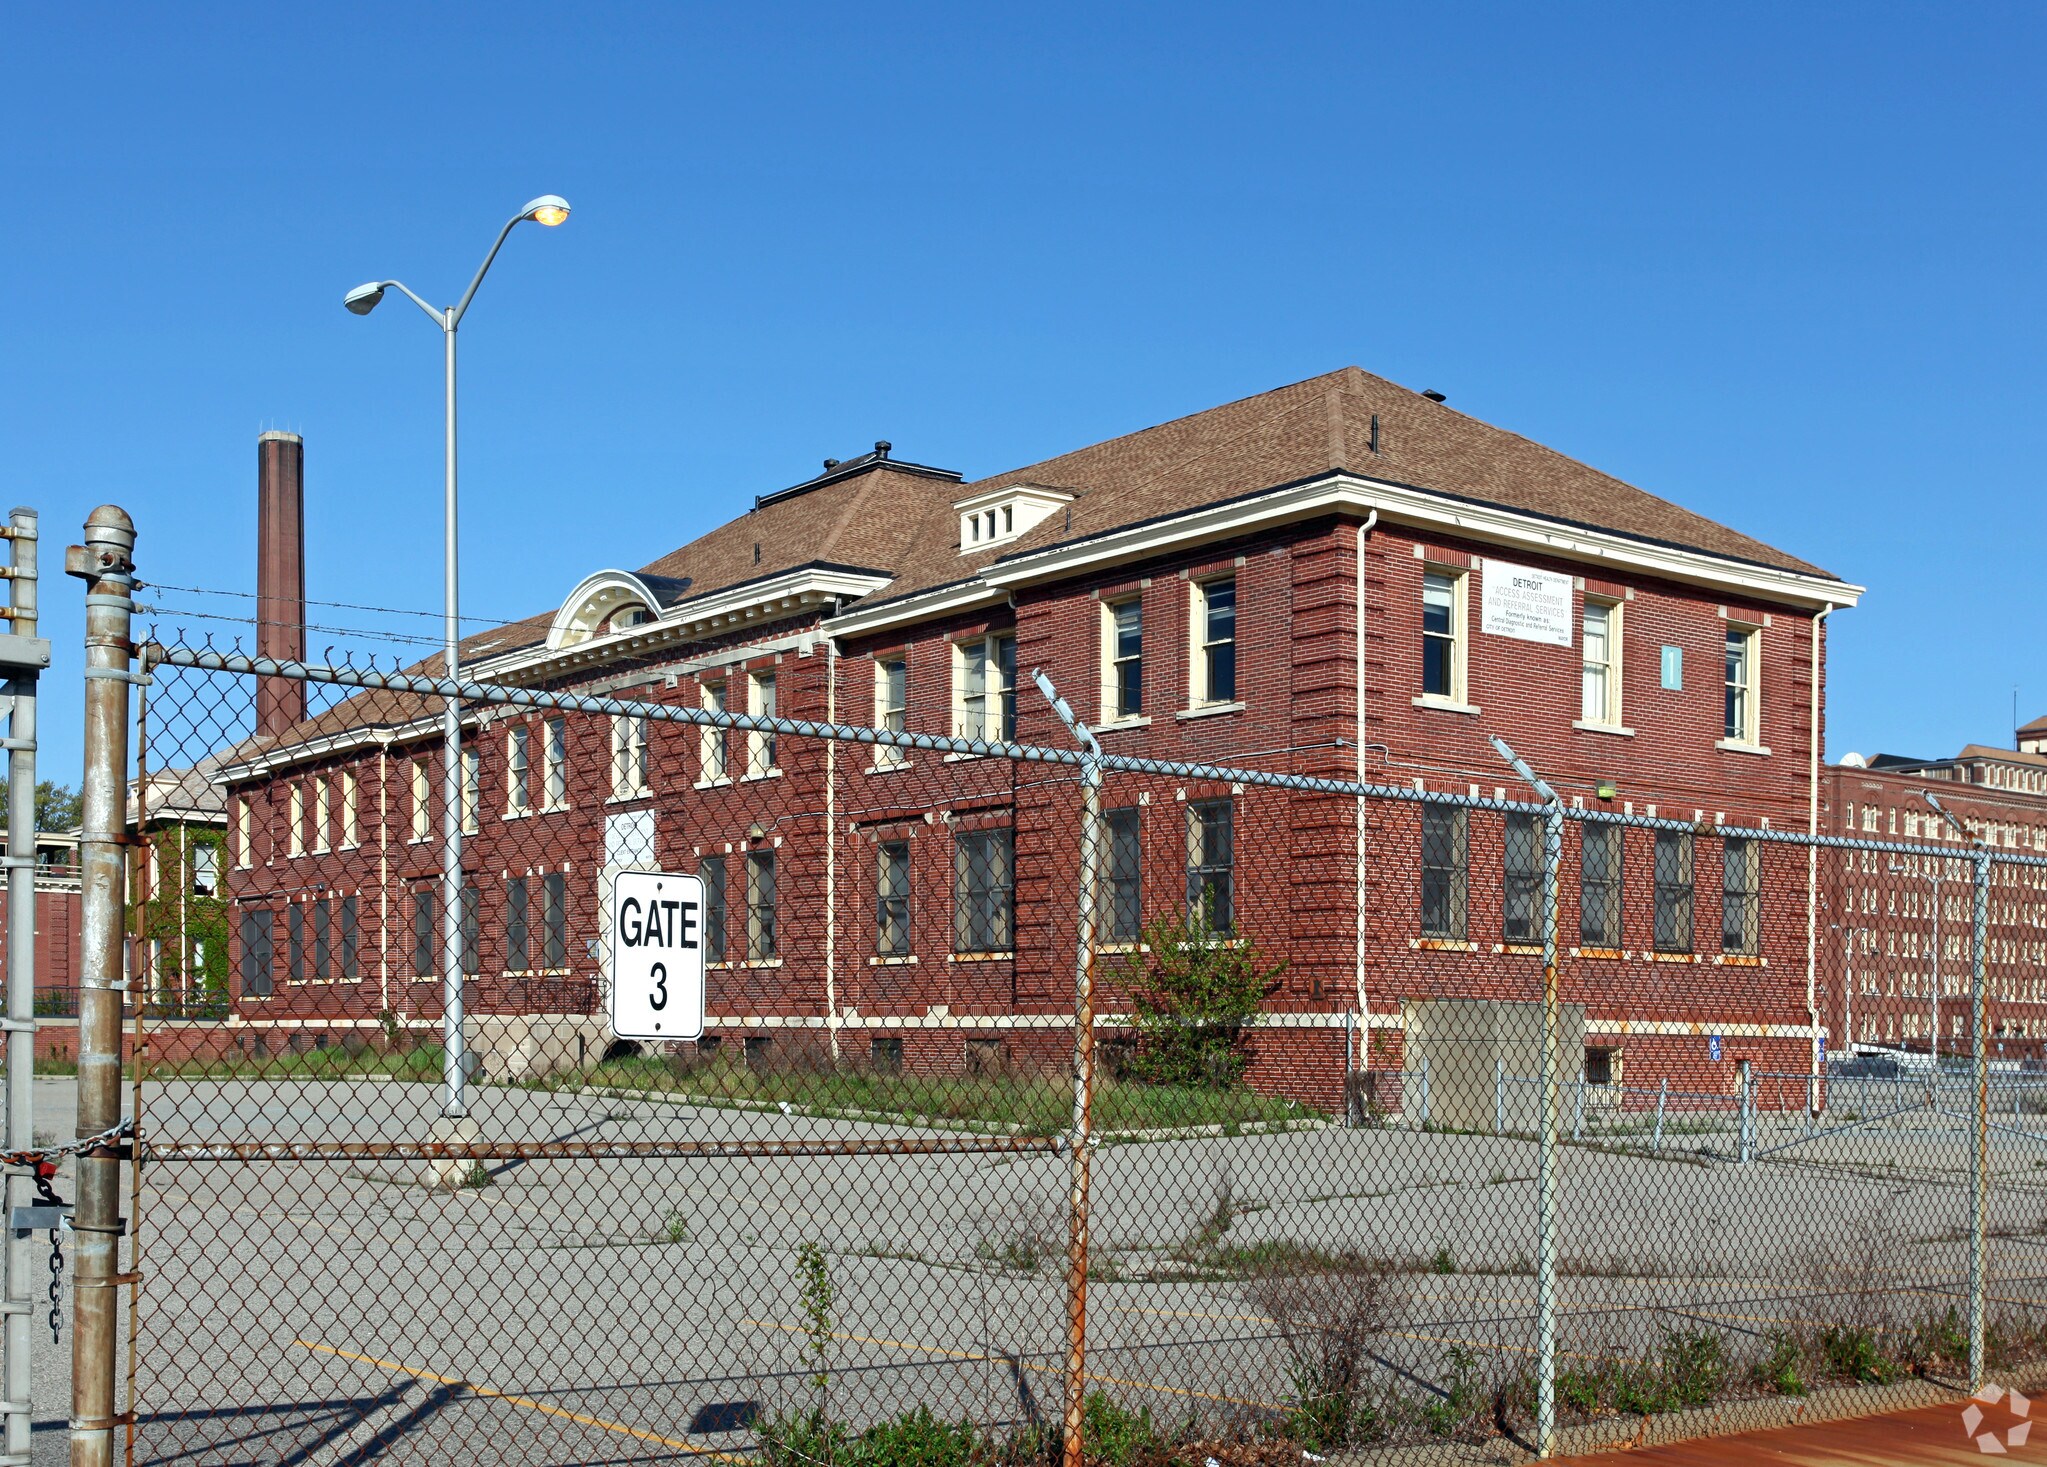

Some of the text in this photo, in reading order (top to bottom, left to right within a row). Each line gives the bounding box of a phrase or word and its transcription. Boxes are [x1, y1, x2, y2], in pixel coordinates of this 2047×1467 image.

[1512, 577, 1543, 591] DETROIT
[1495, 586, 1563, 607] ACCESS ASSESSMENT
[1488, 596, 1565, 618] AND REFERRAL SERVICES
[1505, 610, 1525, 621] Formerly
[1526, 613, 1542, 623] known
[1491, 615, 1505, 624] Central
[1505, 618, 1525, 628] Diagnostic
[1533, 622, 1548, 631] Referral
[1548, 625, 1564, 634] Services
[1501, 626, 1516, 634] DETROIT
[620, 896, 698, 949] GATE
[649, 962, 668, 1011] 3
